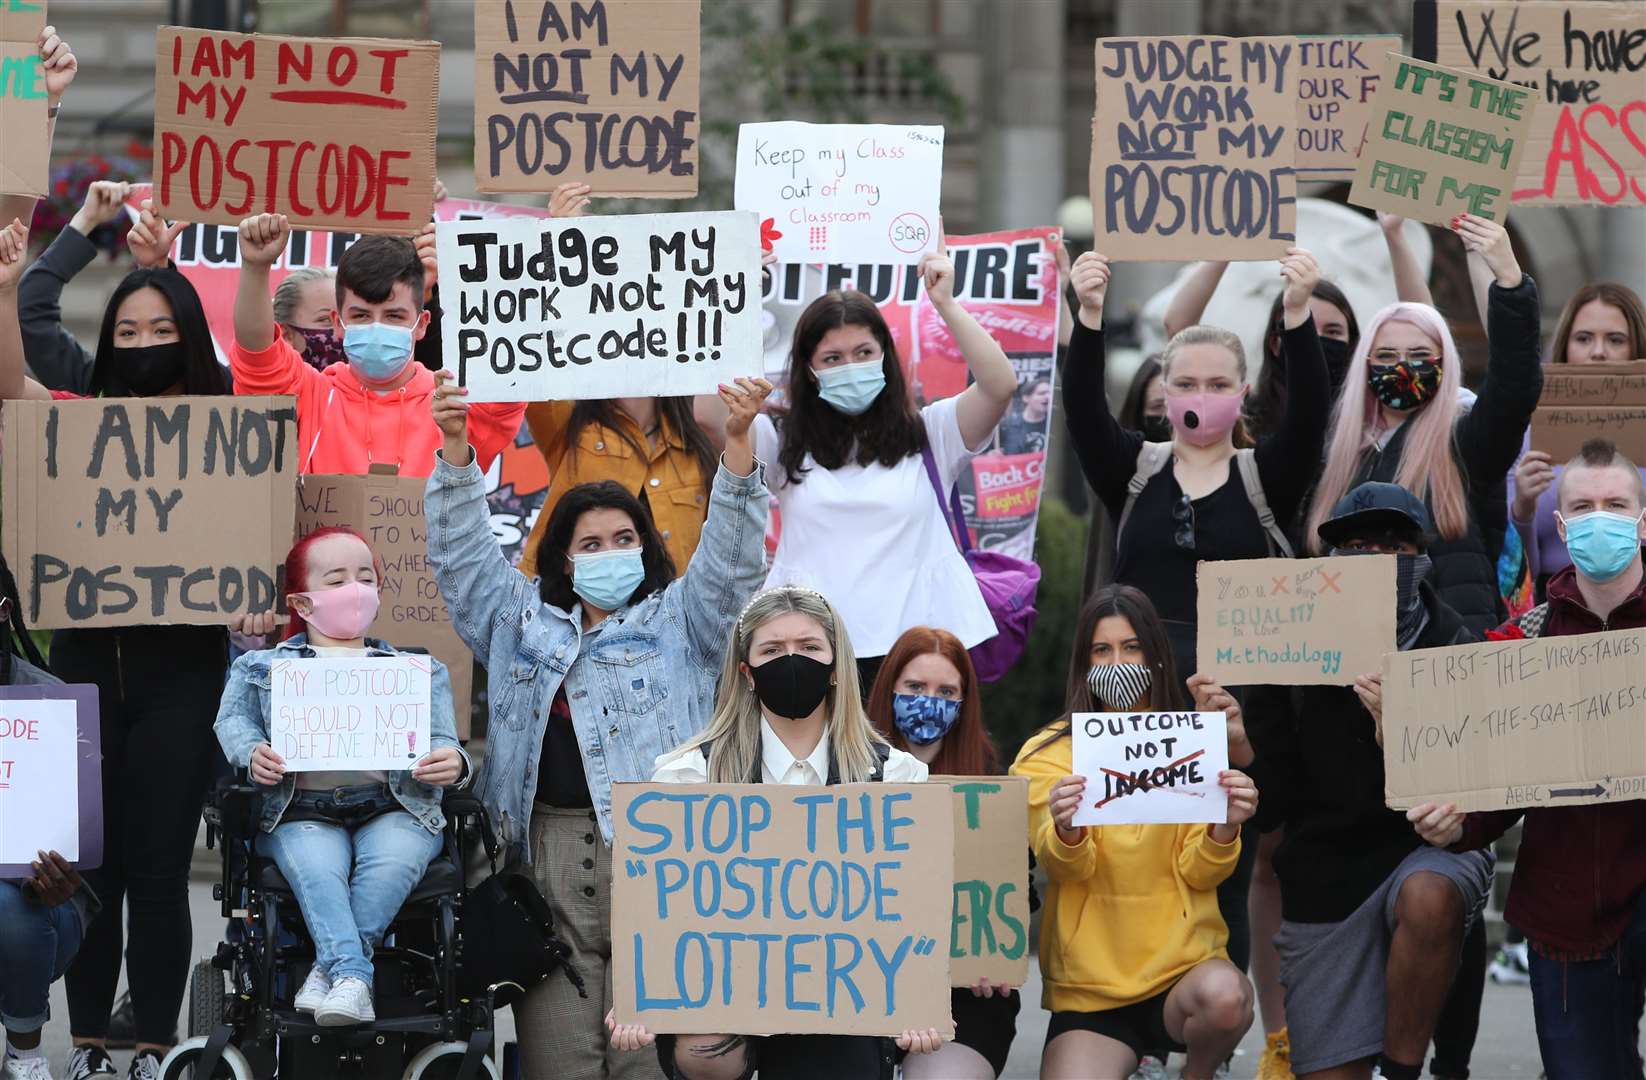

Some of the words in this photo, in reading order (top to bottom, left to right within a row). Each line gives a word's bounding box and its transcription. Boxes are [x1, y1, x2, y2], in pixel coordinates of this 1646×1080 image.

[505, 0, 519, 42] I
[537, 0, 609, 46] AM
[1456, 6, 1542, 71] We
[1564, 8, 1646, 73] have
[172, 36, 182, 76] I
[191, 36, 255, 79] AM
[277, 43, 409, 94] NOT
[494, 49, 592, 94] NOT
[610, 50, 684, 101] MY
[1102, 39, 1232, 82] JUDGE
[1240, 41, 1291, 93] MY
[176, 81, 247, 127] MY
[1124, 80, 1254, 122] WORK
[1297, 77, 1351, 100] OUR
[1467, 78, 1529, 121] THE
[1308, 102, 1340, 122] UP
[487, 109, 697, 178] POSTCODE
[754, 138, 805, 179] Keep
[818, 148, 846, 178] my
[856, 137, 905, 159] Class
[1117, 120, 1207, 154] NOT
[1218, 123, 1285, 158] MY
[1297, 128, 1348, 153] OUR
[160, 131, 411, 221] POSTCODE
[780, 177, 813, 200] out
[820, 178, 840, 197] of
[855, 183, 880, 206] my
[1370, 159, 1427, 201] FOR
[1435, 175, 1502, 221] ME
[789, 207, 872, 225] Classroom
[1105, 162, 1296, 242] POSTCODE
[894, 226, 927, 242] SQA
[457, 227, 619, 287] Judge
[45, 405, 59, 479] I
[86, 403, 191, 481] AM
[203, 406, 297, 477] NOT
[978, 464, 1023, 489] Back
[95, 486, 183, 537] MY
[297, 486, 337, 513] WE
[985, 489, 1025, 513] Fight
[369, 526, 400, 543] TO
[380, 575, 403, 598] AY
[417, 576, 439, 599] FO
[1216, 602, 1315, 627] EQUALITY
[1216, 642, 1342, 675] Methodology
[283, 669, 311, 697] MY
[324, 668, 420, 697] POSTCODE
[276, 704, 362, 733] SHOULD
[375, 703, 425, 730] NOT
[1084, 713, 1205, 738] OUTCOME
[284, 732, 363, 760] DEFINE
[1125, 737, 1178, 761] NOT
[1104, 761, 1205, 800] INCOME
[626, 791, 771, 855] STOP
[793, 792, 915, 855] THE
[950, 879, 1027, 961] ERS
